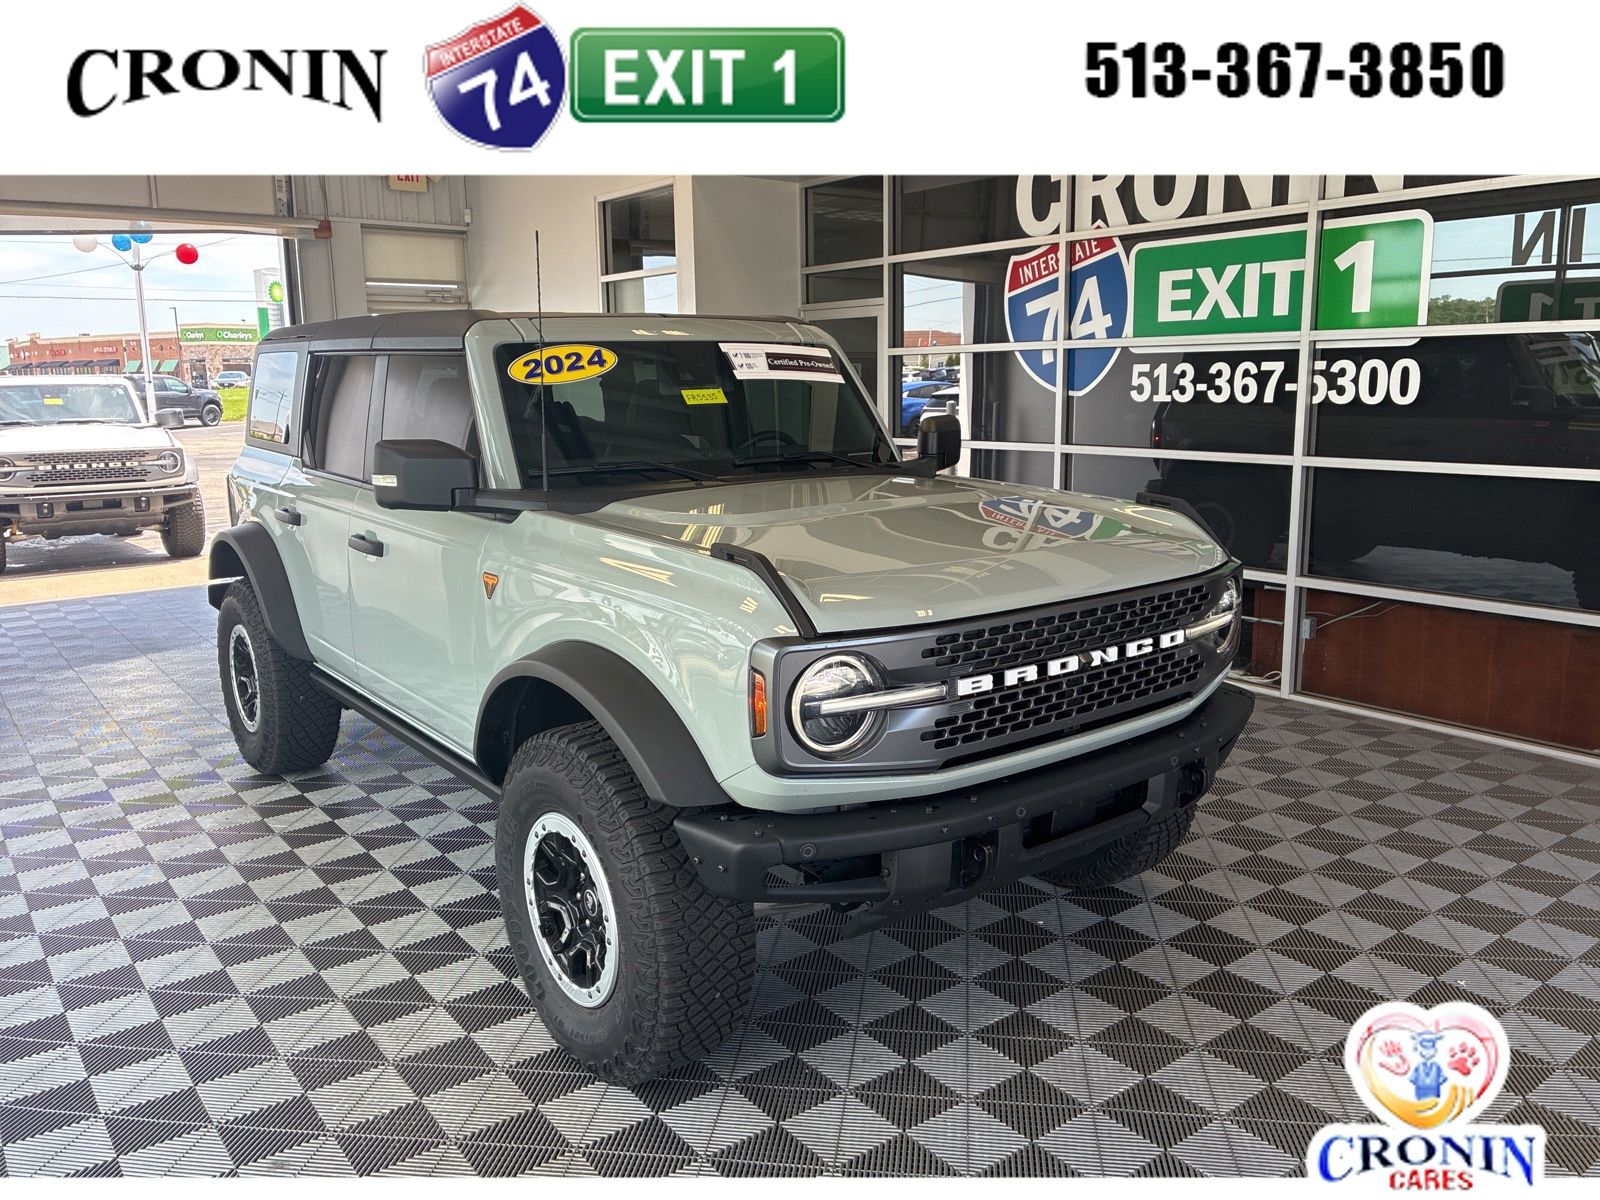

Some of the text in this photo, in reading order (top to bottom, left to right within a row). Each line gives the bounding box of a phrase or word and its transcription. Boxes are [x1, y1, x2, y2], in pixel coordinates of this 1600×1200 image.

[1015, 175, 1404, 237] CRON
[1018, 239, 1101, 285] INTERATE
[1157, 240, 1375, 323] EXIT 1
[1025, 275, 1113, 366] 74
[522, 349, 607, 380] 2024
[767, 357, 799, 367] Certified
[798, 359, 835, 370] Pre-Owned
[1129, 358, 1422, 406] 513-367-5300
[957, 628, 1185, 697] BRONCO
